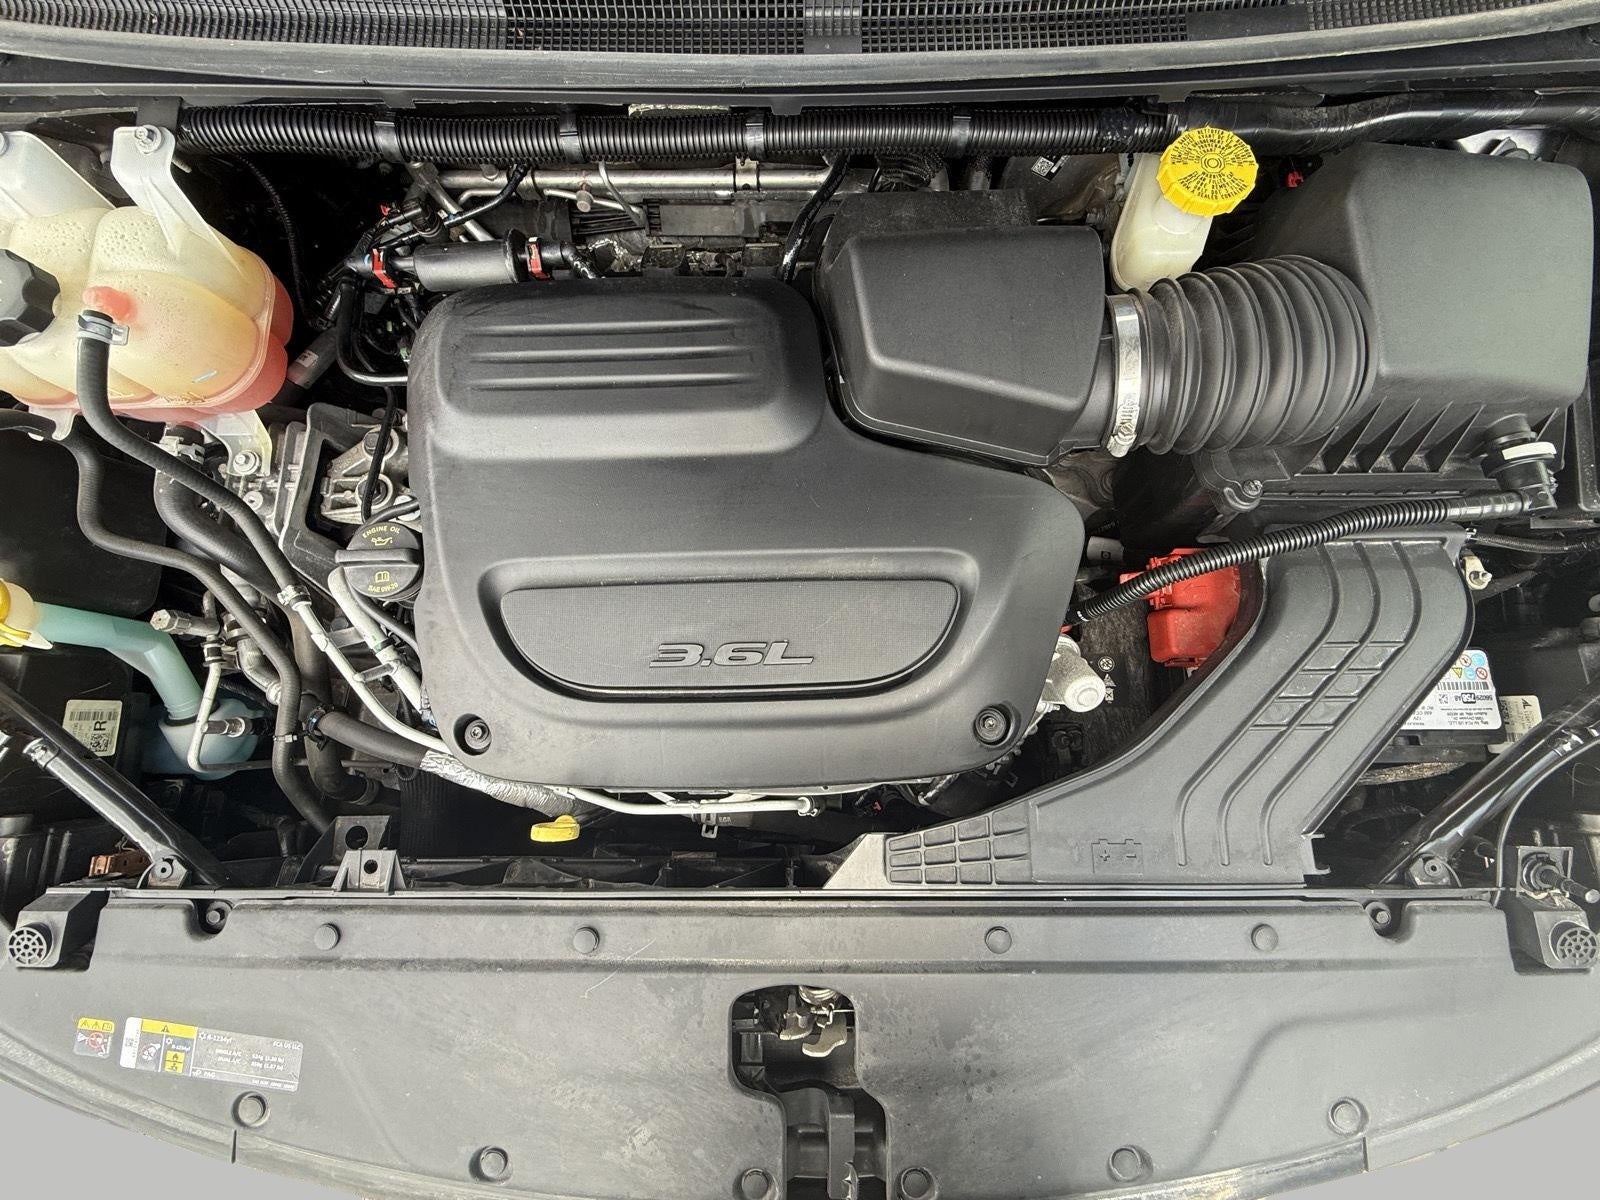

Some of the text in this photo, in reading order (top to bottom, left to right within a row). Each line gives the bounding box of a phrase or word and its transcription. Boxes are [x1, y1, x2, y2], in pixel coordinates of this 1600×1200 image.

[362, 525, 401, 539] ENGINE OIL
[649, 640, 815, 669] 3.6L
[93, 720, 107, 731] R
